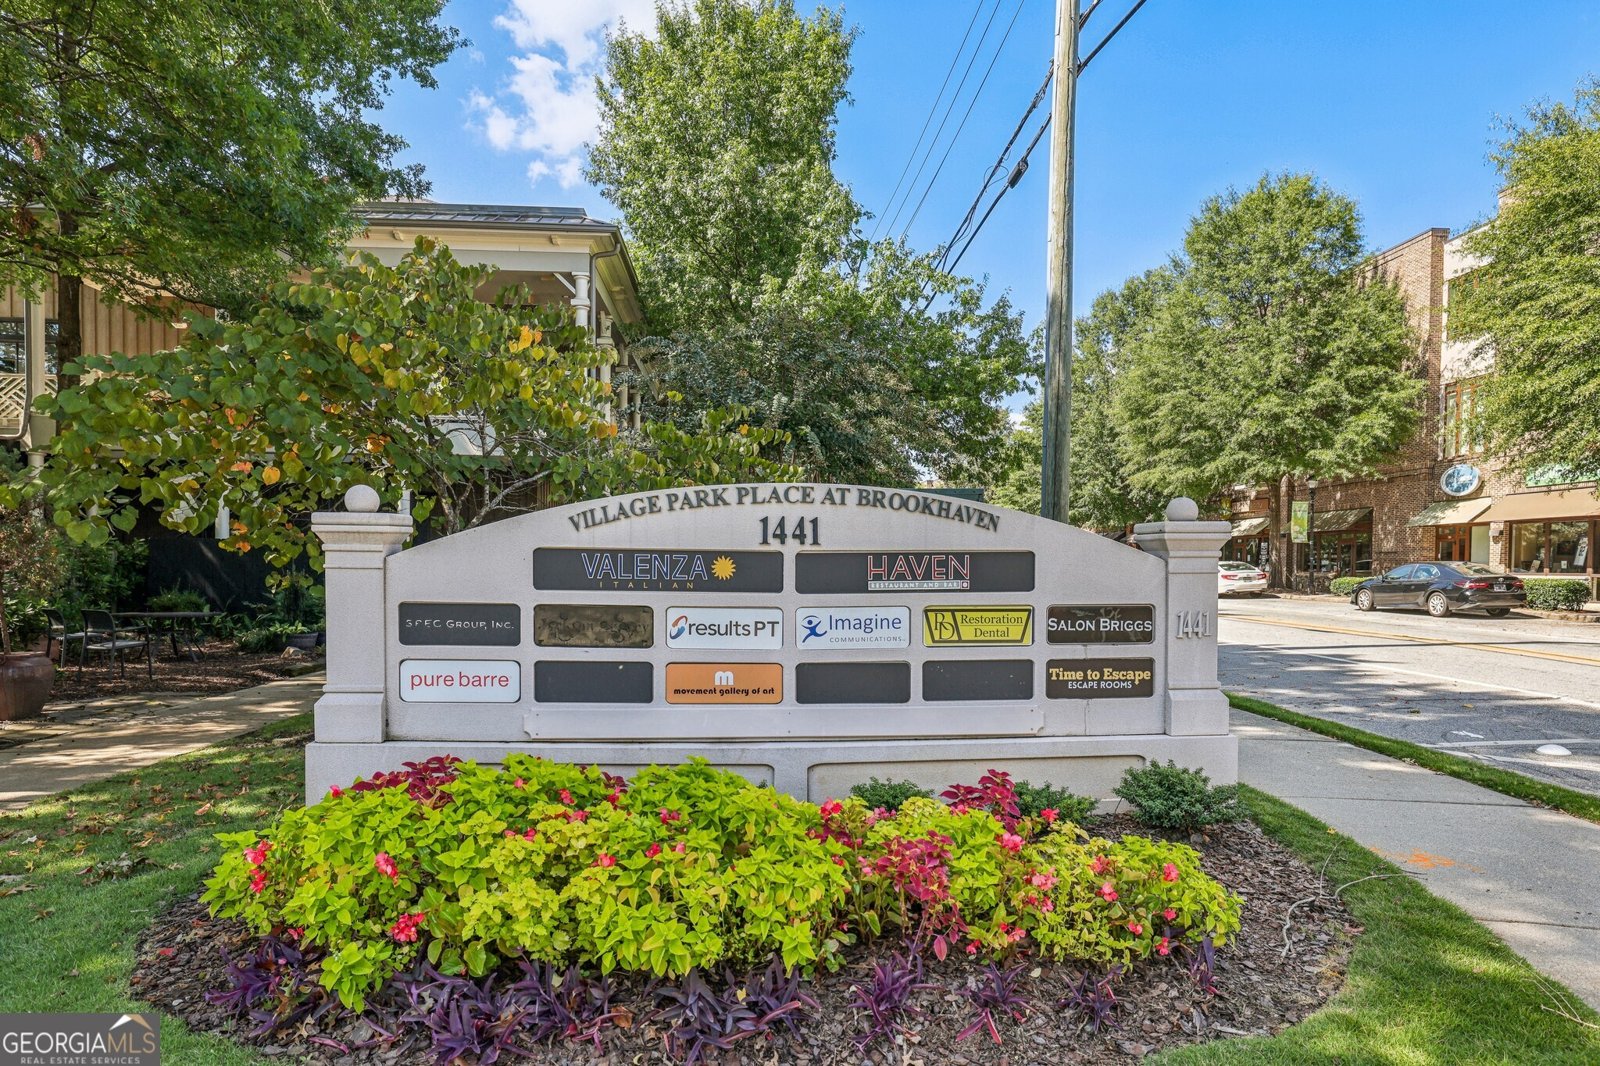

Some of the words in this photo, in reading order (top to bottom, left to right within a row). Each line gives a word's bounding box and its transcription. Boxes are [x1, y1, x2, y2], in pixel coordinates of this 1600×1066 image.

[568, 494, 662, 533] VILLAGE
[666, 487, 731, 512] PARK
[736, 485, 815, 504] PLACE
[820, 487, 850, 505] AT
[856, 488, 1000, 533] BROOKHAVEN
[759, 515, 821, 546] 1441
[581, 553, 708, 581] VALENZA
[867, 554, 970, 580] HAVEN
[870, 581, 919, 589] RESTAURANT
[491, 620, 515, 629] INC.
[829, 613, 902, 634] Imagine
[960, 614, 1024, 625] Restoration
[1048, 618, 1096, 631] SALON
[1100, 617, 1153, 632] BRIGGS
[1176, 610, 1212, 639] 1441
[829, 635, 903, 643] COMMUNICATIONS
[974, 627, 1010, 638] Dental
[410, 674, 455, 690] pure
[459, 671, 510, 688] barre
[1049, 668, 1085, 680] Time
[1086, 669, 1100, 680] to
[1103, 668, 1151, 685] Escape
[673, 687, 717, 695] movement
[719, 687, 749, 696] gallery
[751, 687, 760, 695] of
[762, 687, 775, 695] art
[1068, 681, 1098, 689] ESCAPE
[1100, 681, 1132, 689] ROOMS
